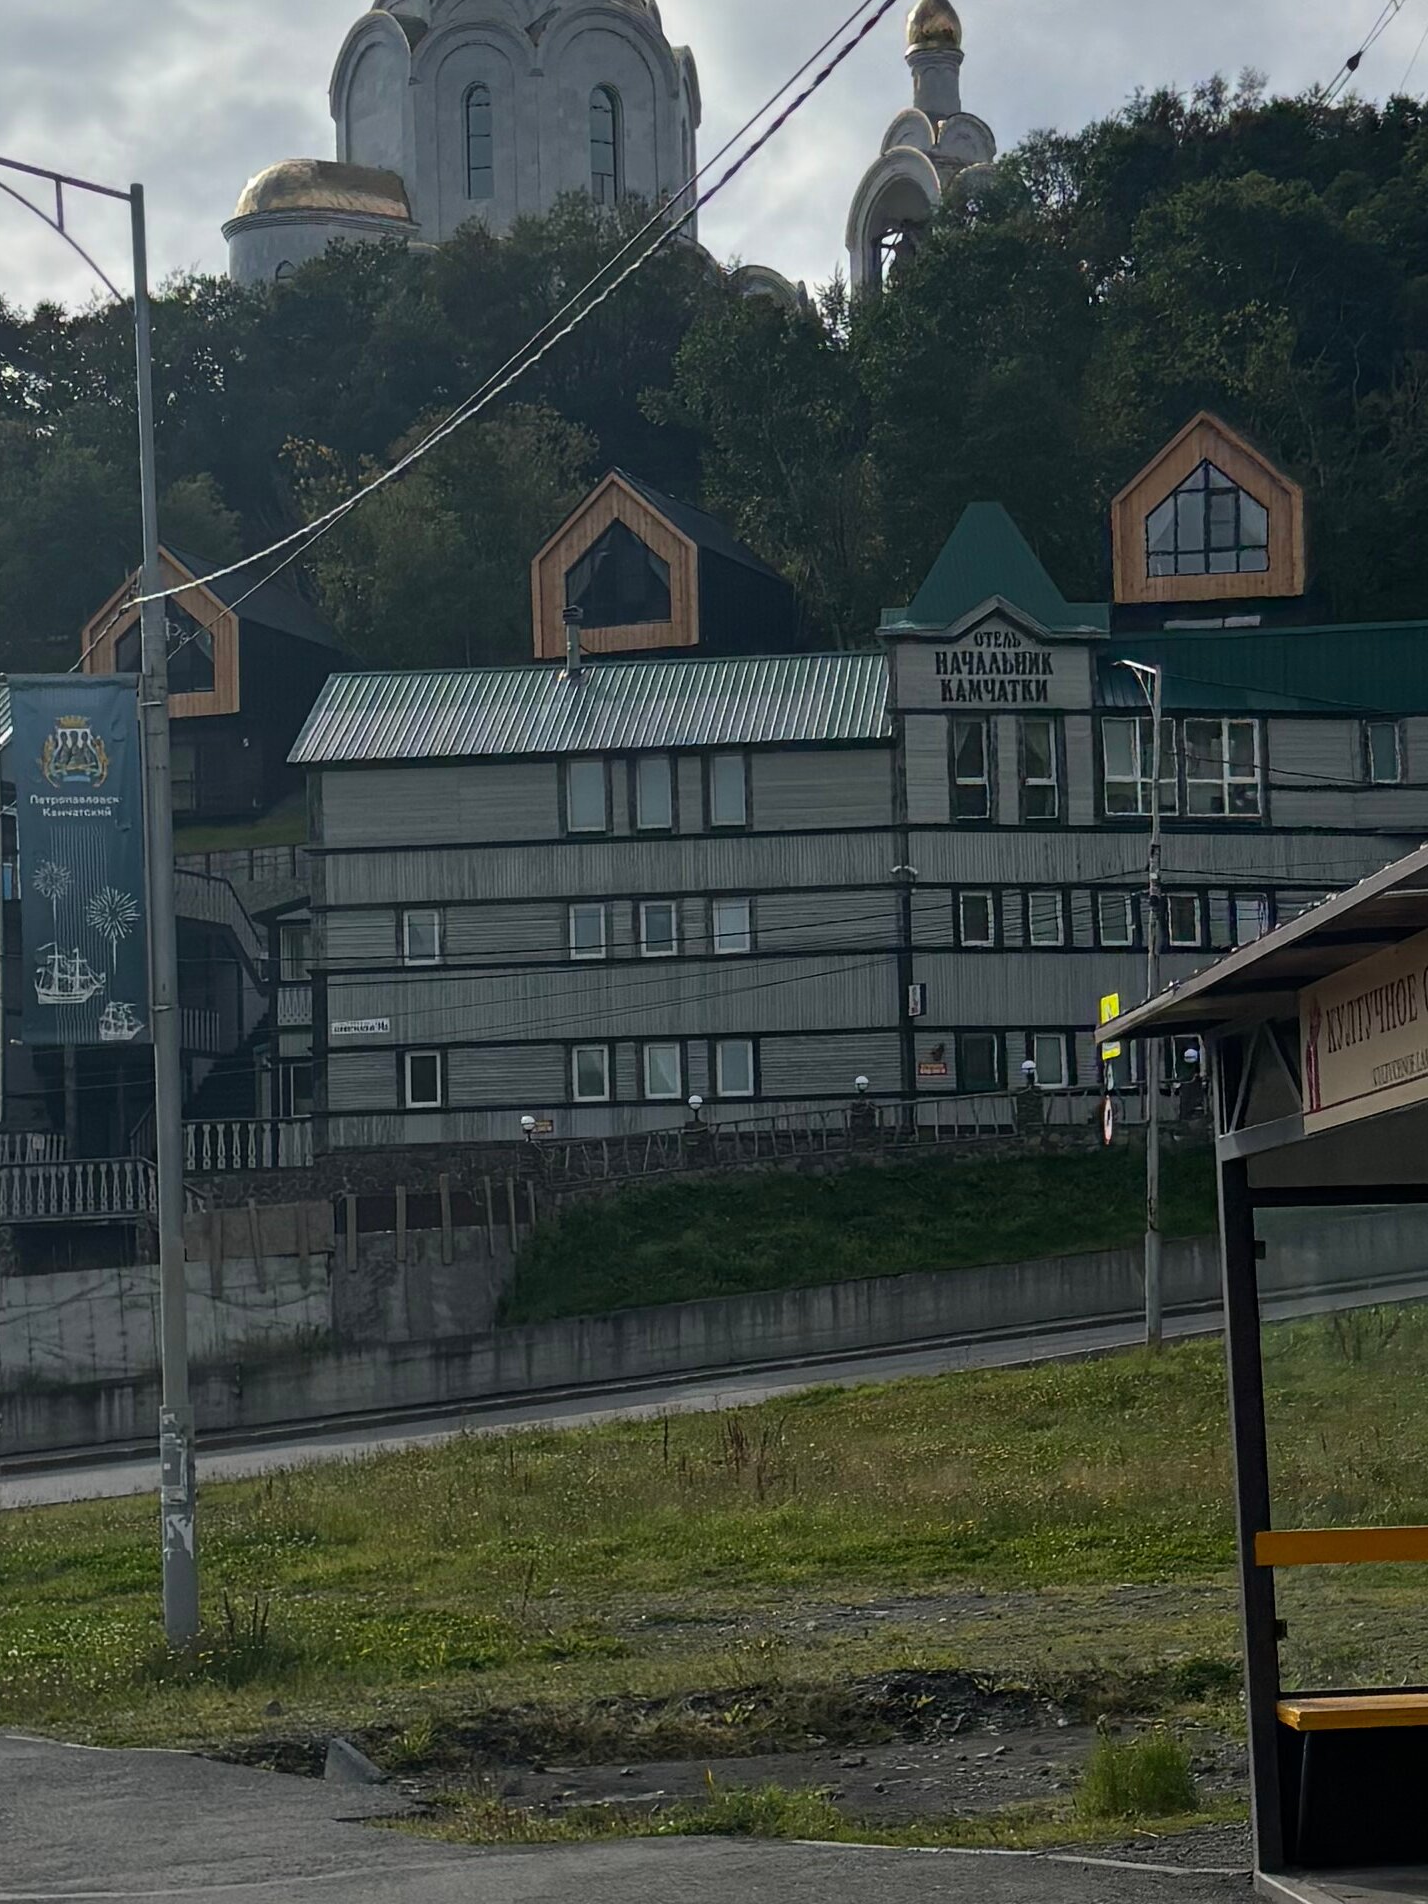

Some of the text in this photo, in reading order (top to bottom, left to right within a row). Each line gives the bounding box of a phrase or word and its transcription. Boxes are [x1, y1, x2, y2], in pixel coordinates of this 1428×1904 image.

[973, 630, 1022, 648] ОТЕЛЬ
[934, 650, 1054, 676] НАЧАЛЬНИК
[939, 678, 1049, 704] КАМЧАТКИ
[1325, 973, 1418, 1054] КУЛТУЧНОЕ
